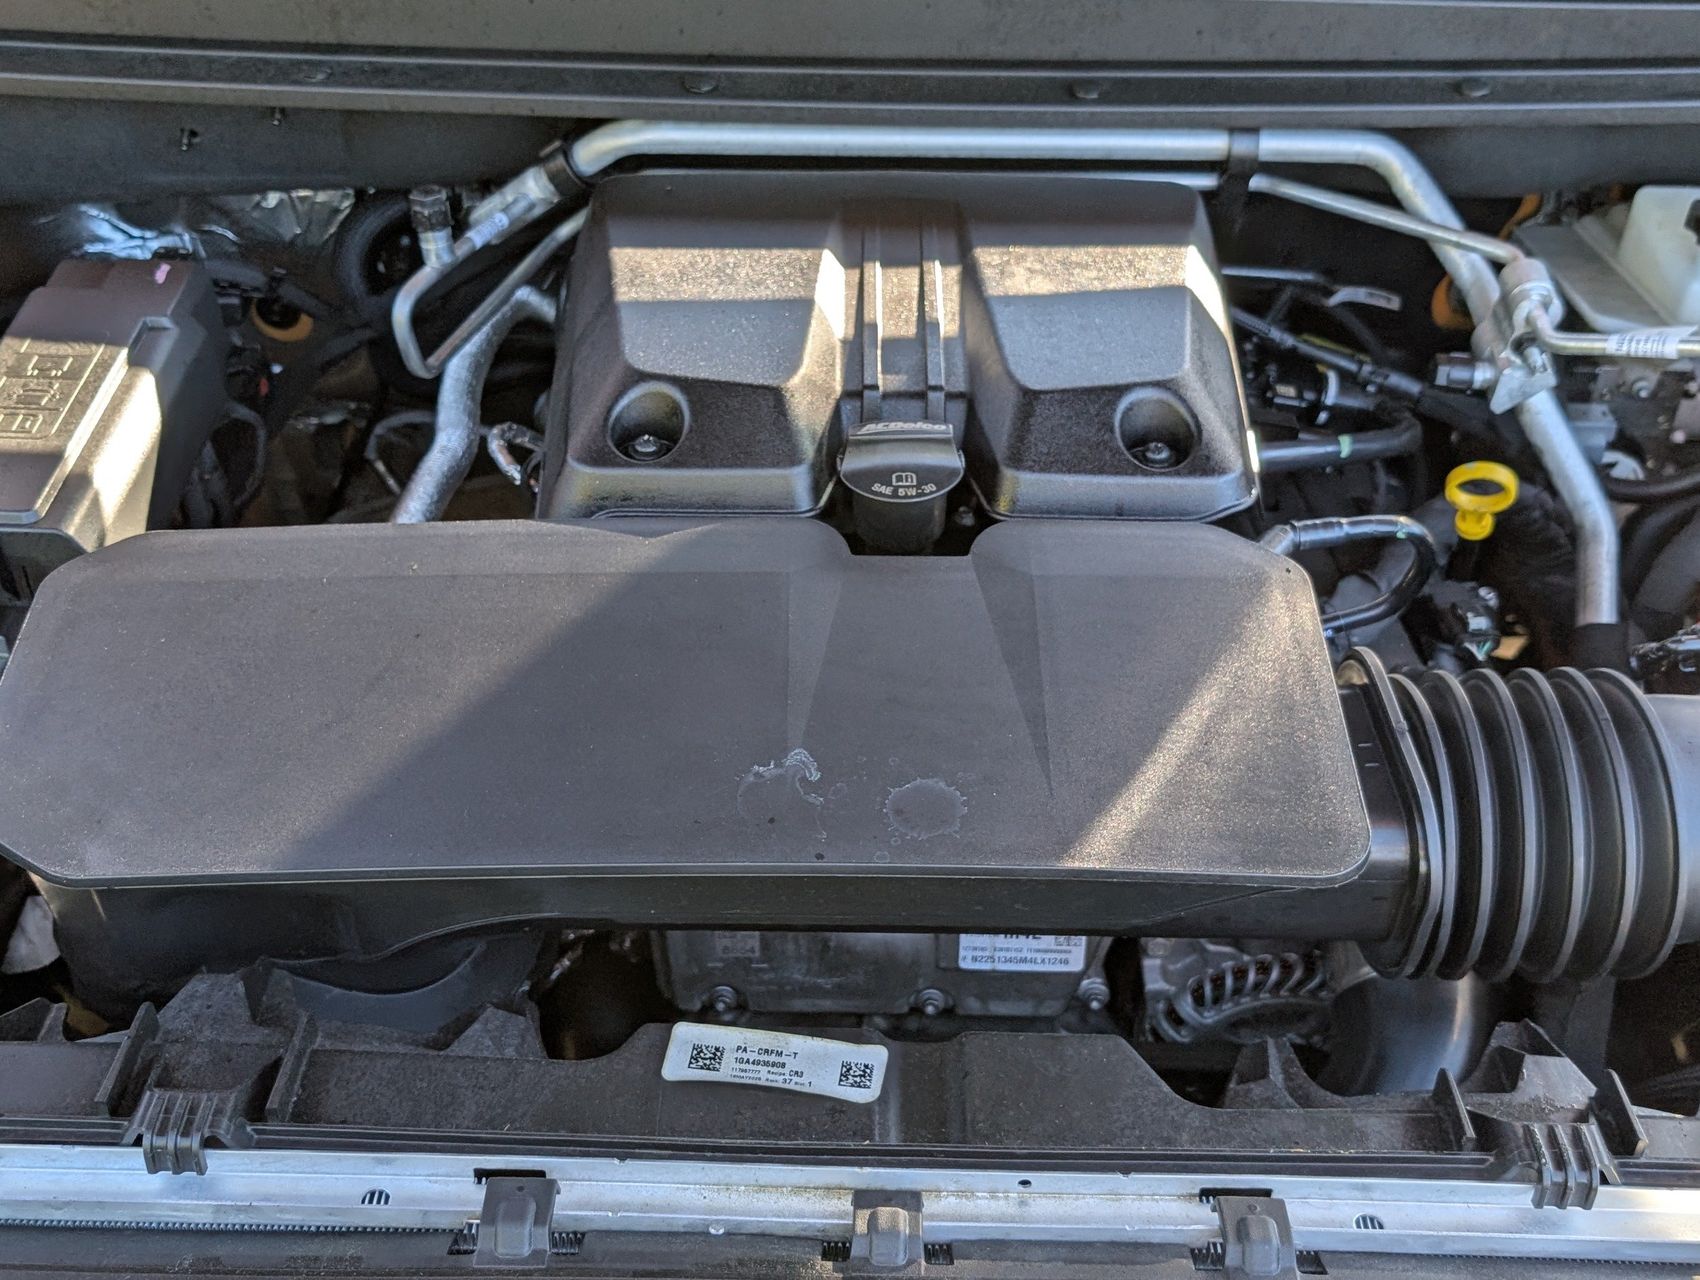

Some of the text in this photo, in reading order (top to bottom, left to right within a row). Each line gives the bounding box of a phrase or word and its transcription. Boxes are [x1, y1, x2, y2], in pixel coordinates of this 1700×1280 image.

[871, 483, 937, 496] SAE 5W-30
[788, 1069, 804, 1078] CR3
